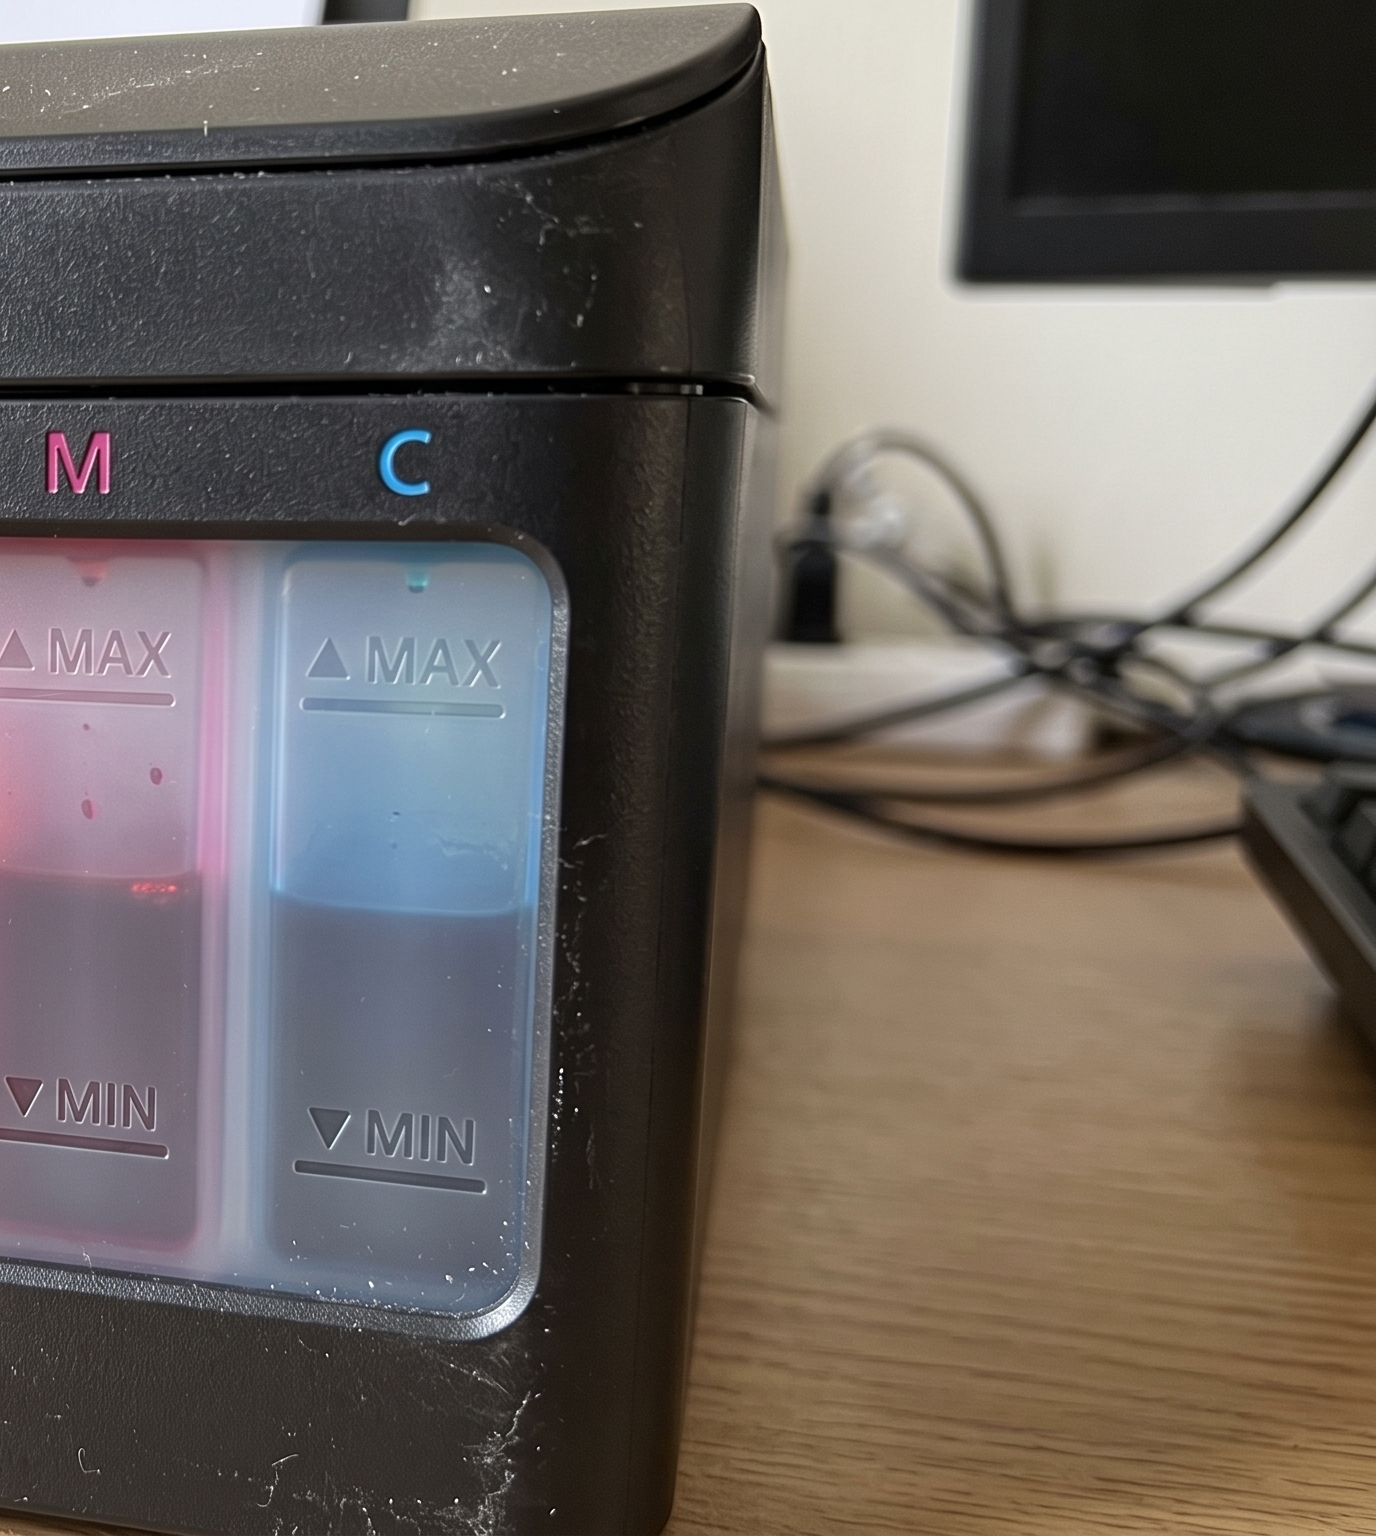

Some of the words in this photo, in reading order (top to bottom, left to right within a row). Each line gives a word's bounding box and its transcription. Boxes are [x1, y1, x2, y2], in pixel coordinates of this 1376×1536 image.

[45, 430, 111, 495] M
[379, 428, 432, 496] C
[48, 628, 171, 678] MAX
[365, 636, 501, 689] MAX
[55, 1077, 157, 1132] MIN
[365, 1109, 475, 1166] MIN
